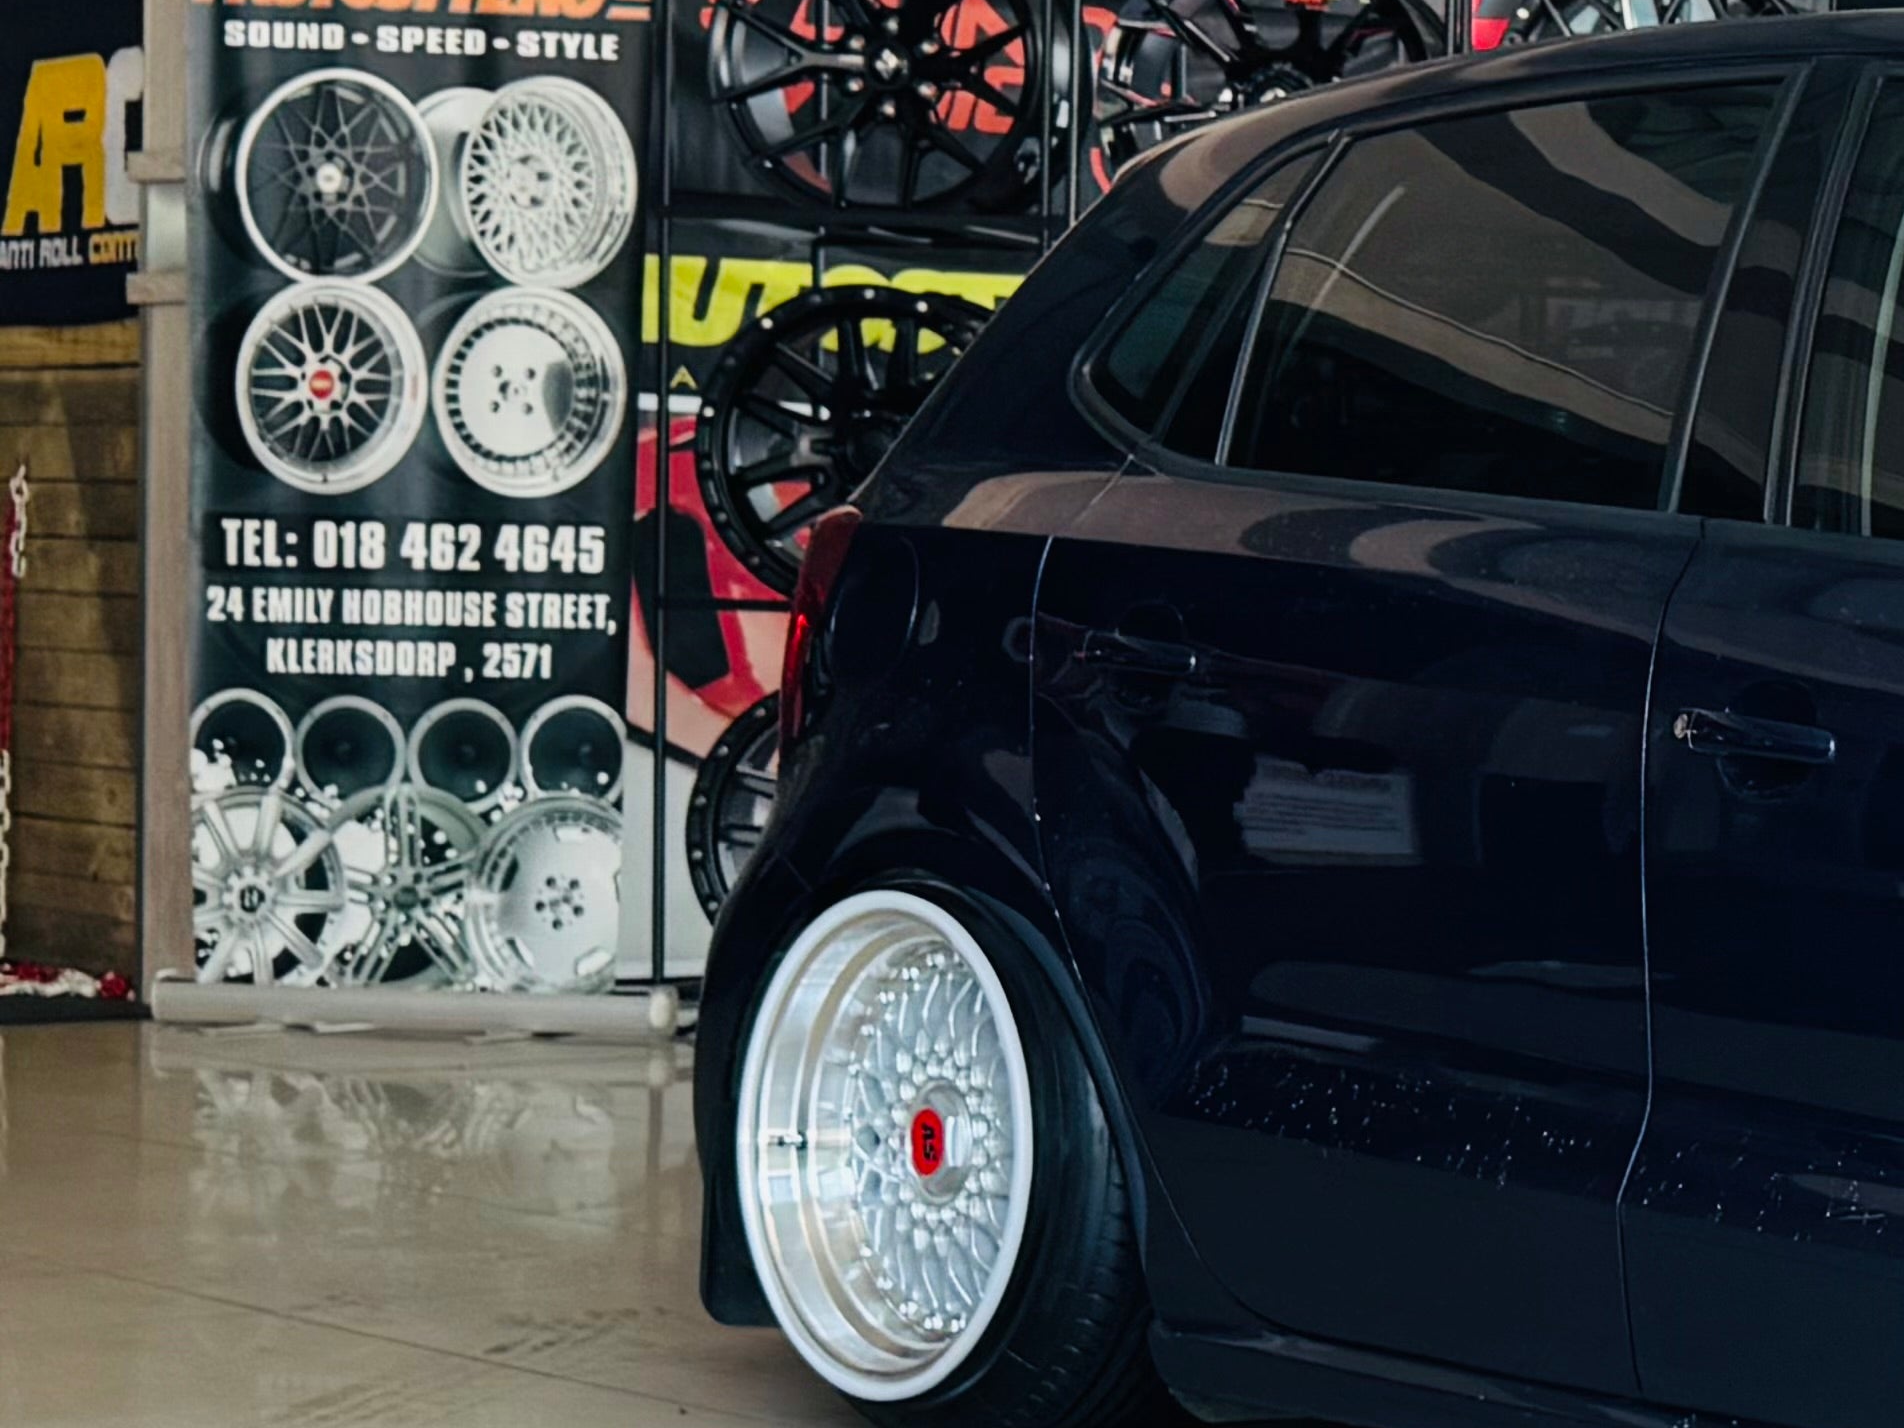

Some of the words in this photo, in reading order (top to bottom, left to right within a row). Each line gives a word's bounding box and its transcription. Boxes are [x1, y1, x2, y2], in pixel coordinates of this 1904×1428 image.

[224, 20, 344, 50] SOUND
[375, 25, 486, 55] SPEED
[516, 30, 620, 60] STYLE
[221, 518, 299, 567] TEL:
[312, 521, 385, 568] 018
[400, 523, 480, 571] 462
[494, 524, 605, 573] 4645
[206, 586, 245, 621] 24
[252, 587, 334, 624] EMILY
[342, 590, 498, 628] HOBHOUSE
[505, 593, 618, 636] STREET,
[266, 640, 456, 677] KLERKSDORP
[482, 643, 552, 680] 2571
